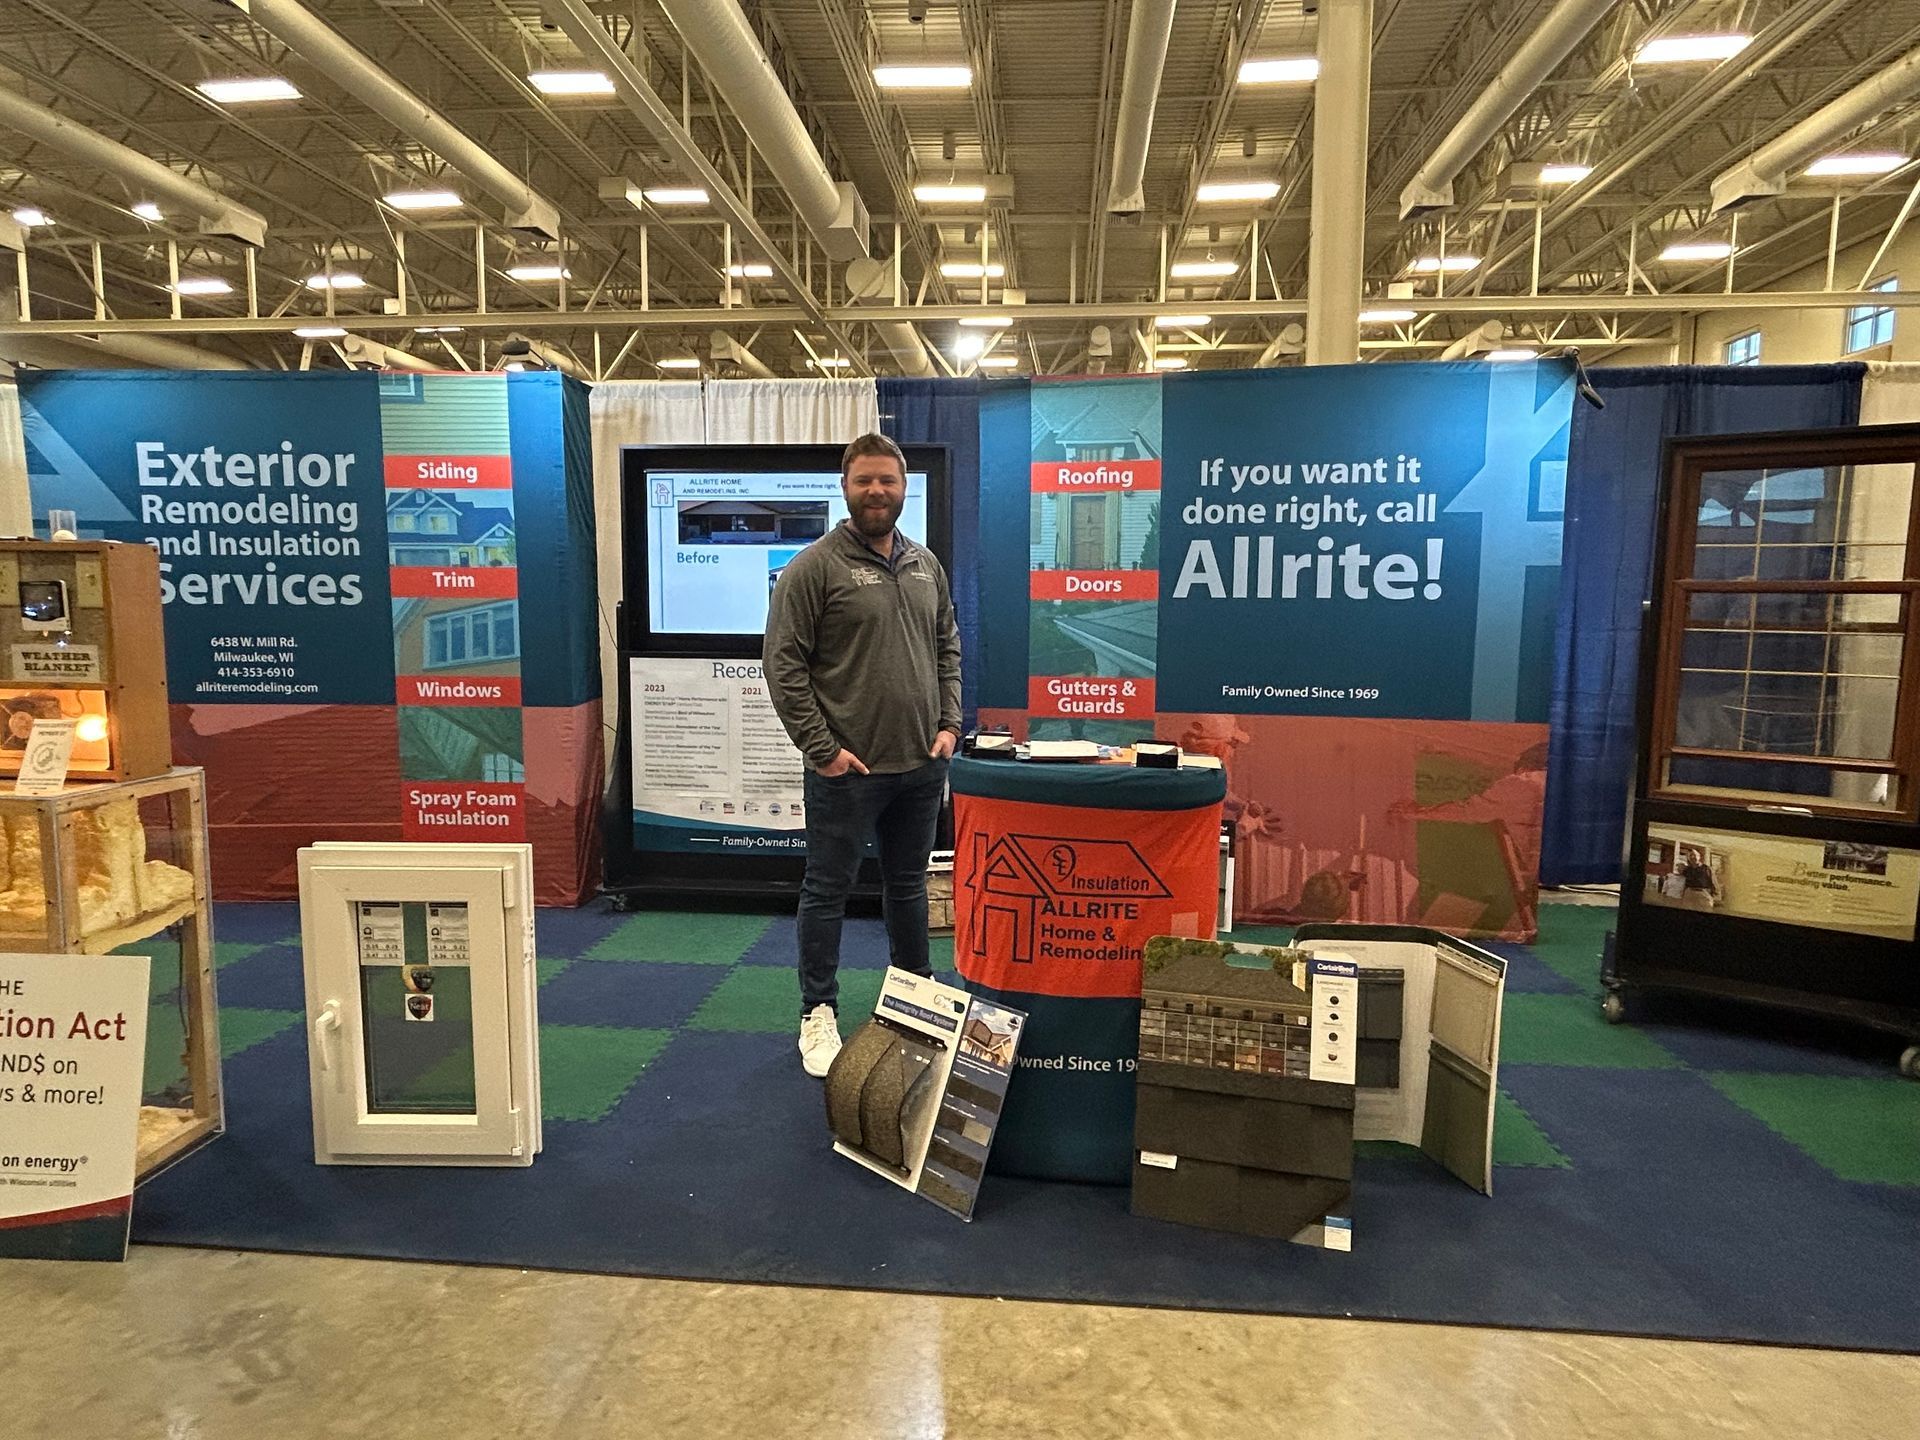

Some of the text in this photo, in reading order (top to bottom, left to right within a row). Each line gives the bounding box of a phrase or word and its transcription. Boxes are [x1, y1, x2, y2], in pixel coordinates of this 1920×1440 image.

[136, 440, 355, 486] Exterior
[417, 462, 478, 484] Siding
[1058, 468, 1134, 489] Roofing
[1200, 454, 1421, 493] If you want it
[141, 494, 358, 532] Remodeling
[1182, 494, 1437, 530] done right, call
[144, 530, 360, 556] and Insulation
[677, 552, 719, 564] Before
[1172, 536, 1444, 601] Allrite!
[160, 562, 363, 606] Services
[432, 571, 475, 588] Trim
[1065, 576, 1122, 594] Doors
[210, 637, 298, 648] 6438 W. Mill Rd.
[22, 652, 90, 661] WEATHER
[214, 652, 294, 664] Milwaukee, WI
[218, 668, 294, 678] 414-353-6910
[196, 682, 318, 695] allriteremodeling.com
[416, 682, 502, 698] Windows
[644, 684, 665, 692] 2023
[1048, 680, 1137, 697] Gutters &
[1222, 685, 1379, 699] Family Owned Since 1969
[1057, 696, 1125, 714] Guards
[410, 790, 516, 809] Spray Foam
[418, 808, 510, 827] Insulation
[722, 836, 790, 848] Family-Owned
[1072, 874, 1150, 890] Insulation
[1041, 900, 1138, 920] ALLRITE
[1040, 923, 1116, 942] Home &
[68, 1012, 126, 1041] Act
[54, 1060, 78, 1075] on
[1068, 1056, 1112, 1071] Since
[1116, 1059, 1139, 1072] 19
[22, 1084, 36, 1102] &
[44, 1086, 104, 1104] more!
[2, 1156, 19, 1167] on
